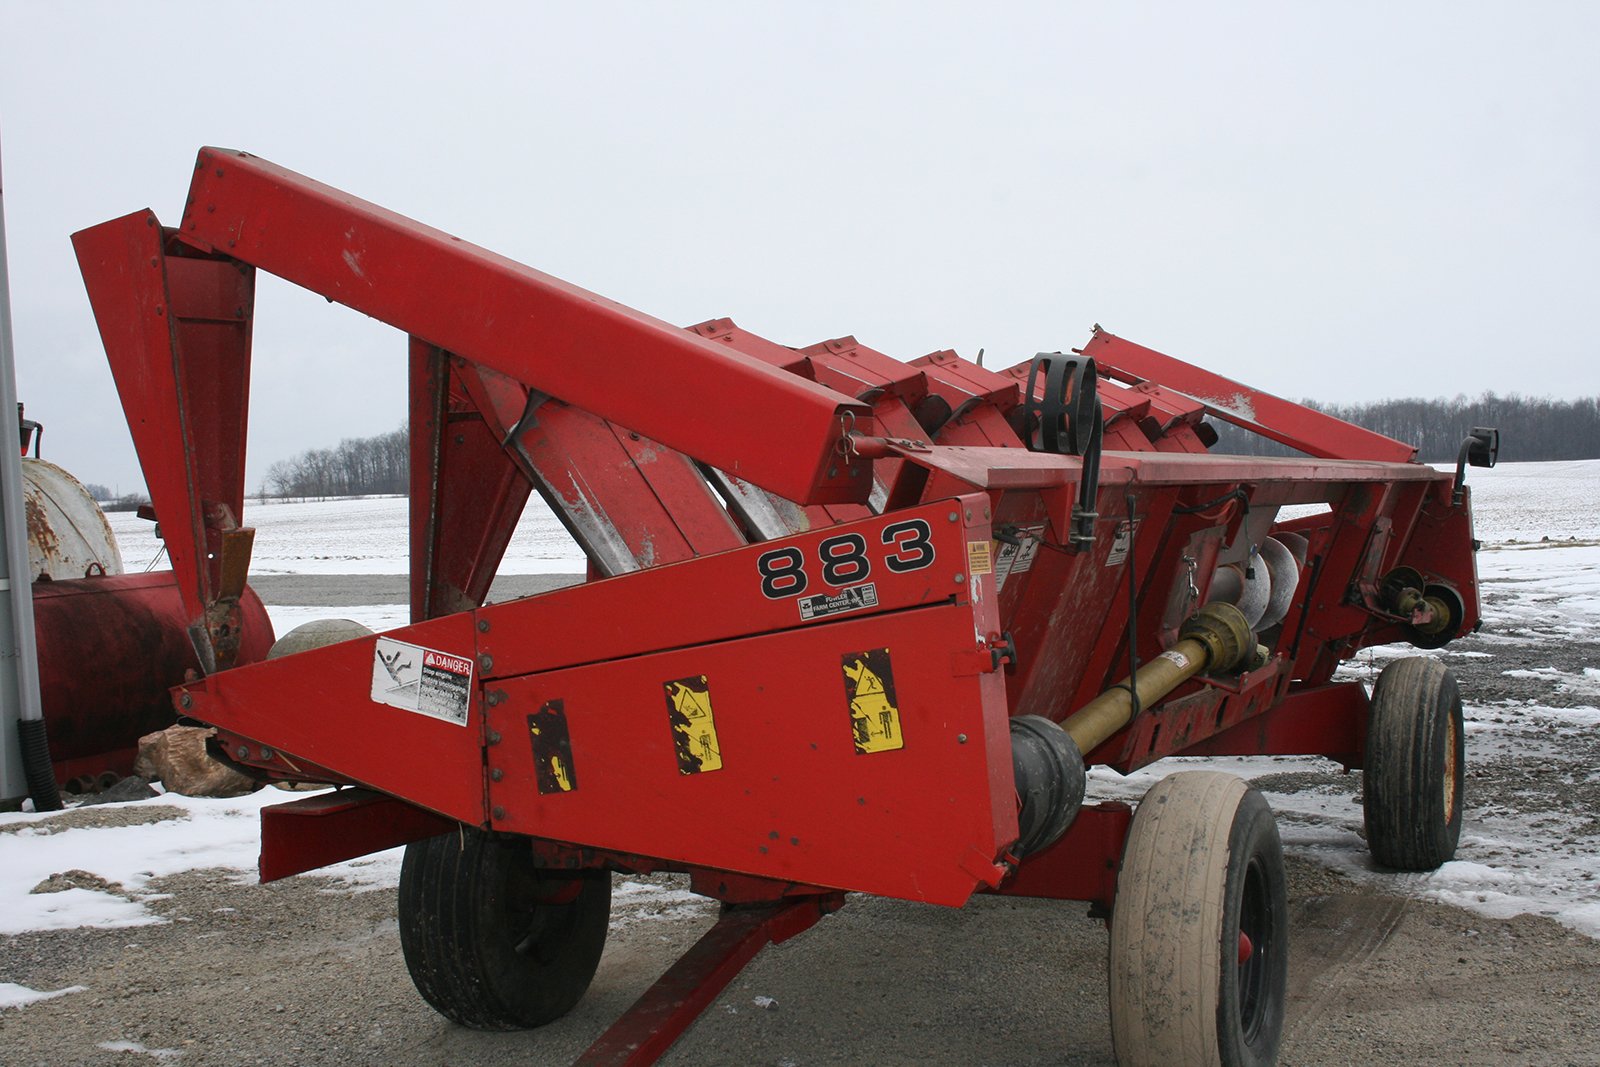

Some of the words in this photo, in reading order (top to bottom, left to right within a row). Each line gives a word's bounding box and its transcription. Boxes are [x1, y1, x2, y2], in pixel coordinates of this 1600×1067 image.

[757, 518, 935, 600] 883
[813, 603, 829, 612] FARM
[436, 655, 470, 675] DANGER
